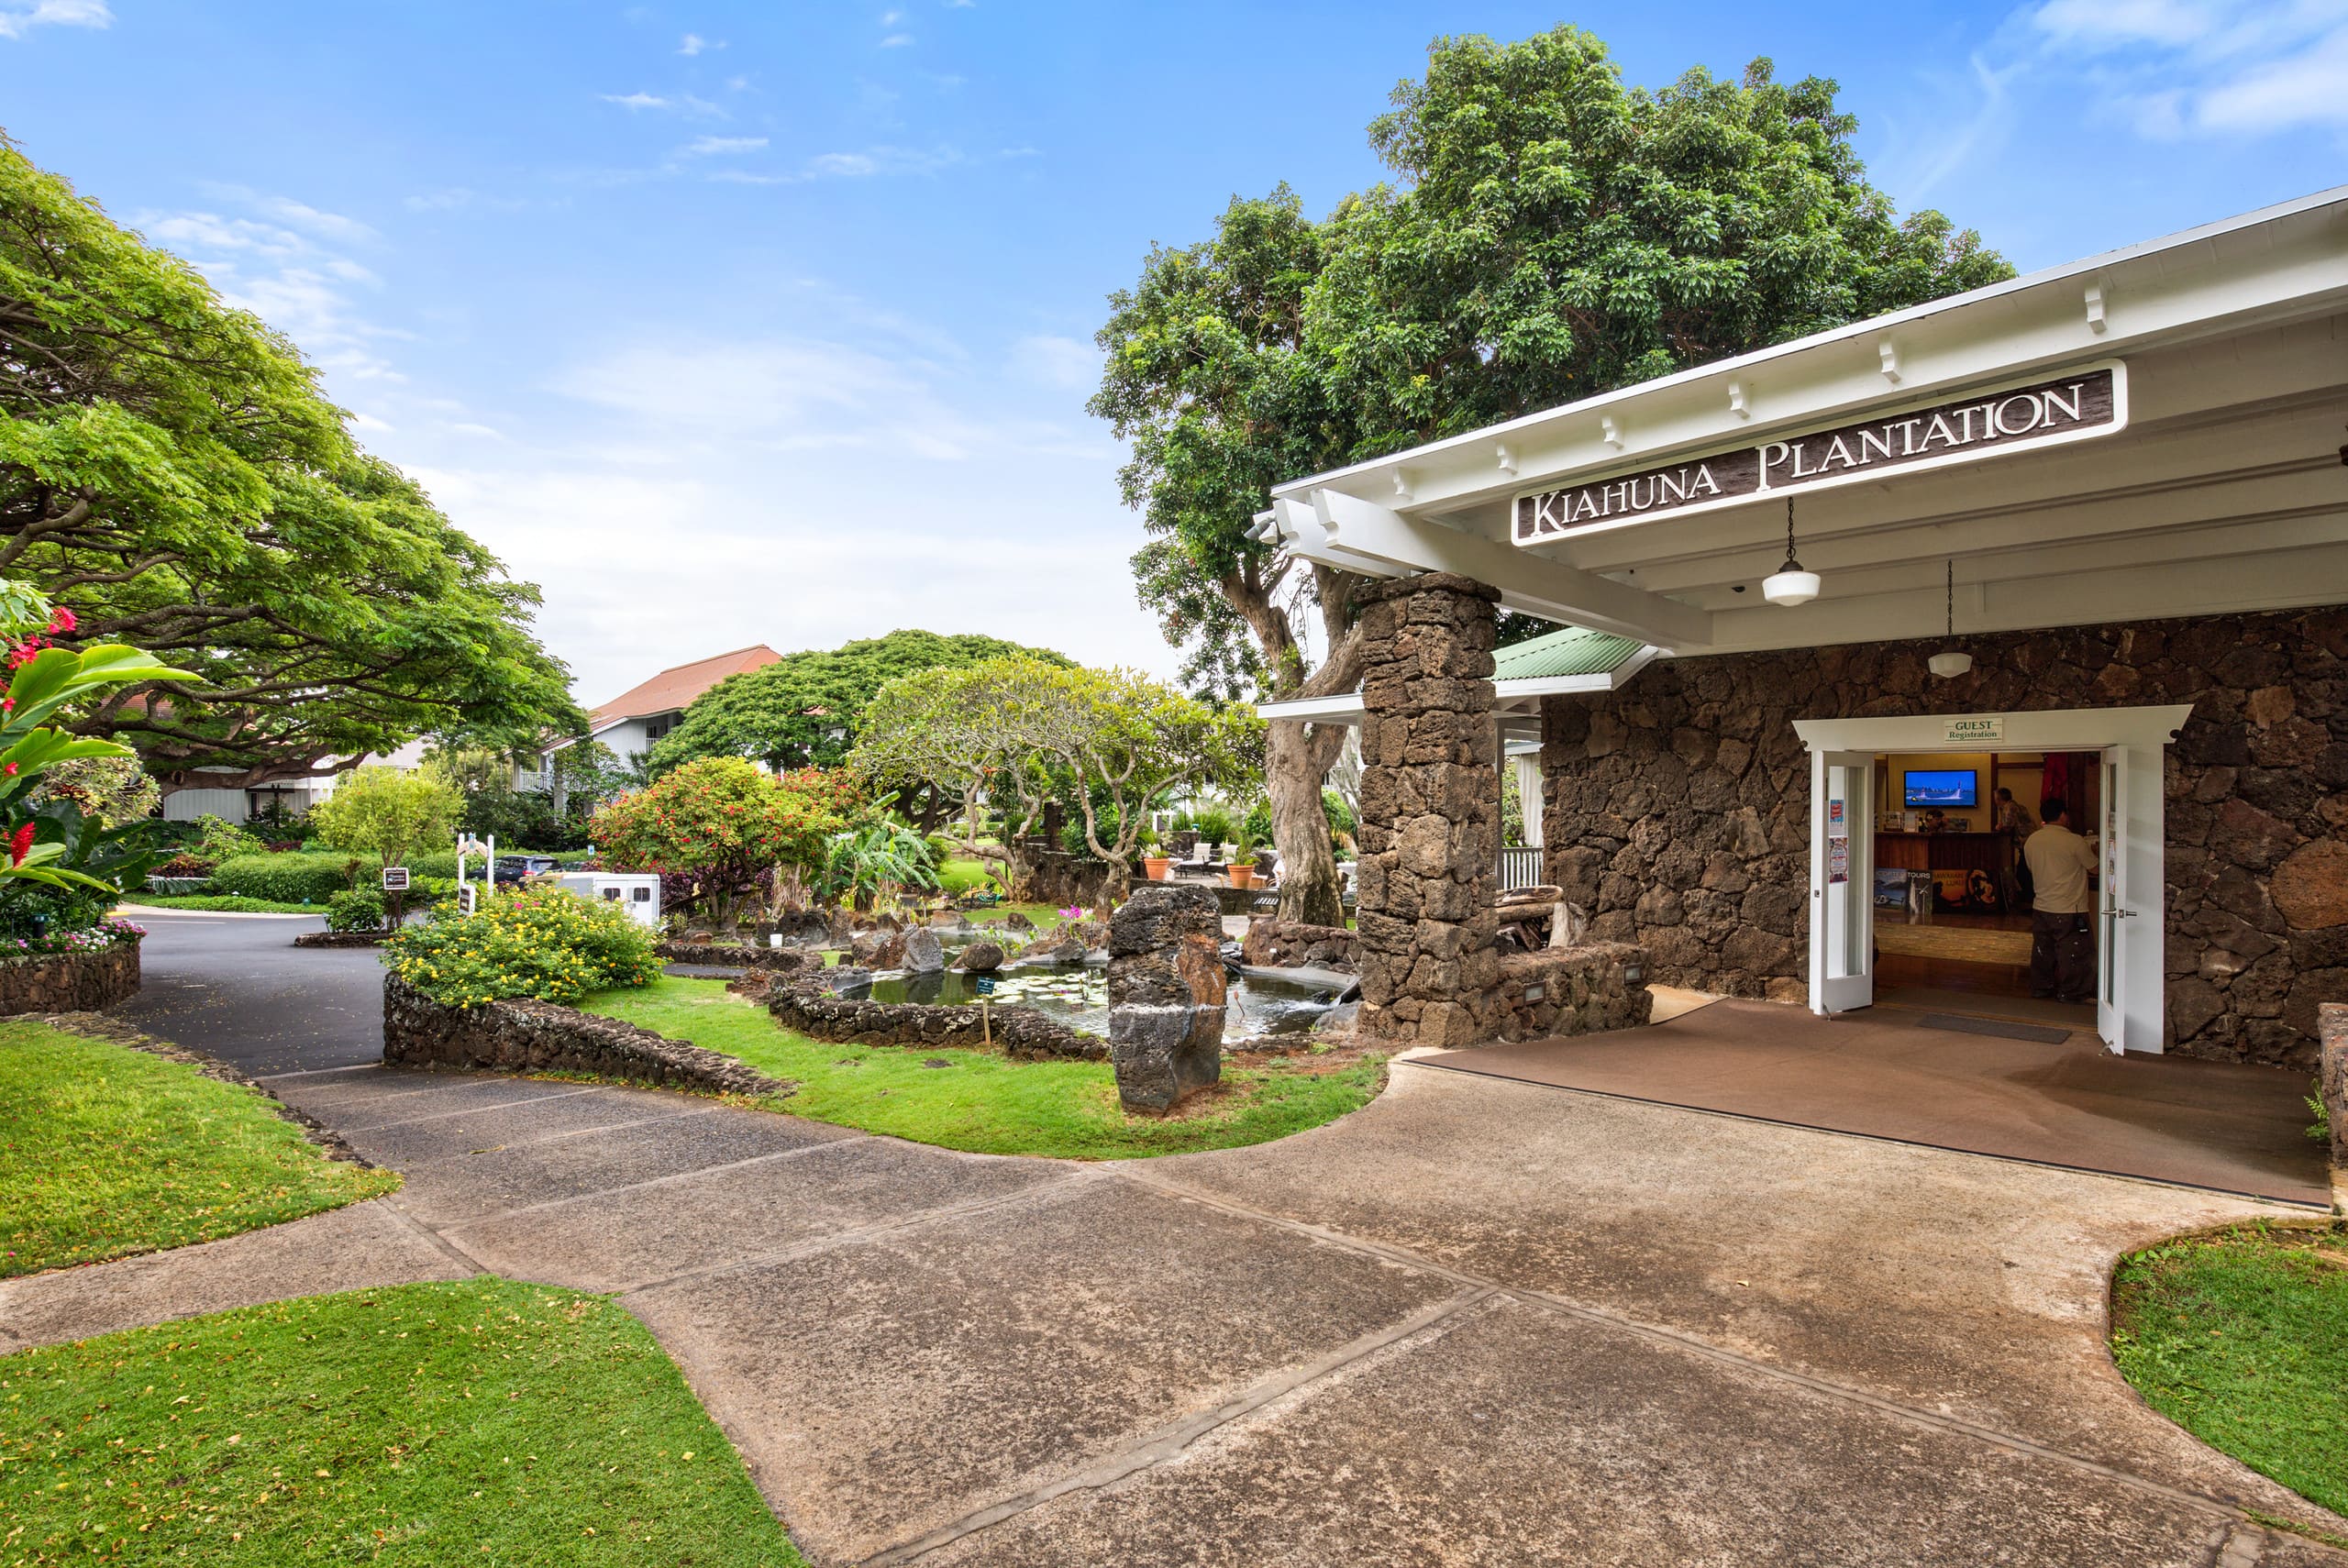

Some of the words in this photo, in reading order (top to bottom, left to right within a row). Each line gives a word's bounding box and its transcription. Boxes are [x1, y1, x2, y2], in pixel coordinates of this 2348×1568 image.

[1530, 463, 1722, 537] KIAHUNA
[1755, 383, 2085, 492] PLANTATION
[1955, 721, 1993, 731] GUEST
[1949, 731, 1998, 740] Registration
[1908, 871, 1931, 879] TOURS
